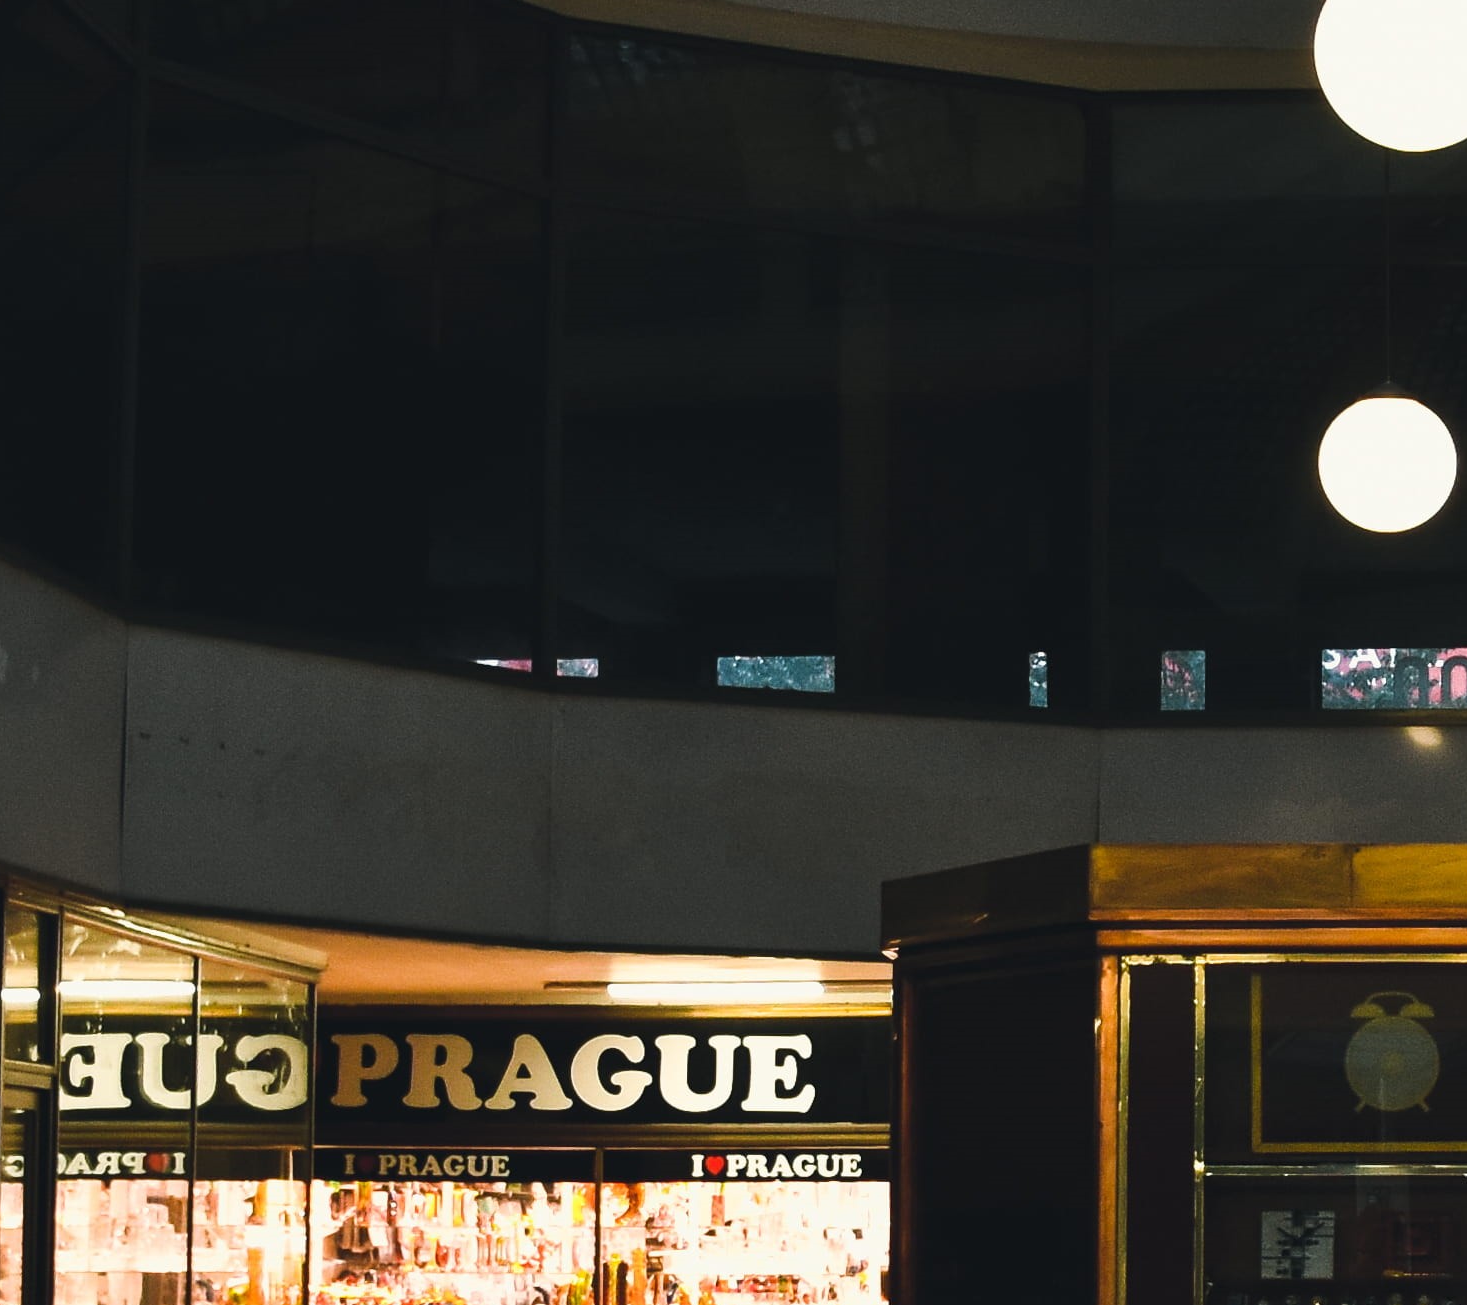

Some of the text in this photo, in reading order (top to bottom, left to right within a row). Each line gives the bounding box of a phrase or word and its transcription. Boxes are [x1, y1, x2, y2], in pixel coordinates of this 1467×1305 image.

[331, 1032, 817, 1114] PRAGUE
[343, 1153, 511, 1179] I PRAGUE
[690, 1153, 863, 1179] I PRAGUE
